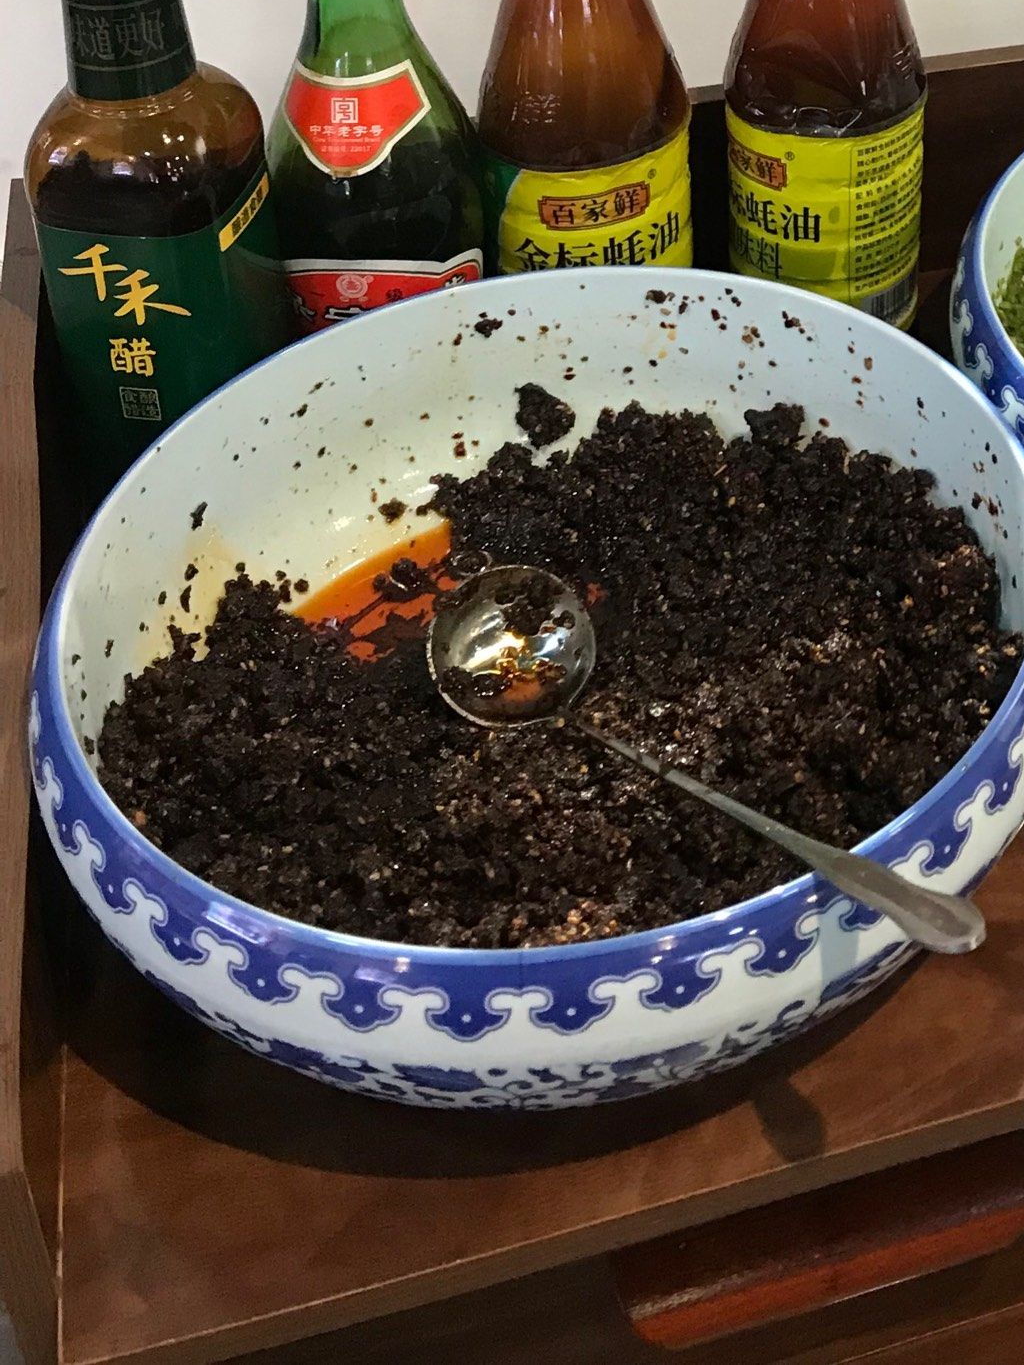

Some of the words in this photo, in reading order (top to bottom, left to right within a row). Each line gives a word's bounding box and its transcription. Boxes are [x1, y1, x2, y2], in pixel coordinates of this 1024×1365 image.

[309, 125, 384, 137] 中华老字号
[551, 188, 641, 225] 百家鲜
[514, 211, 679, 269] 金标蚝油
[58, 243, 192, 326] 千禾
[109, 338, 157, 377] 醋
